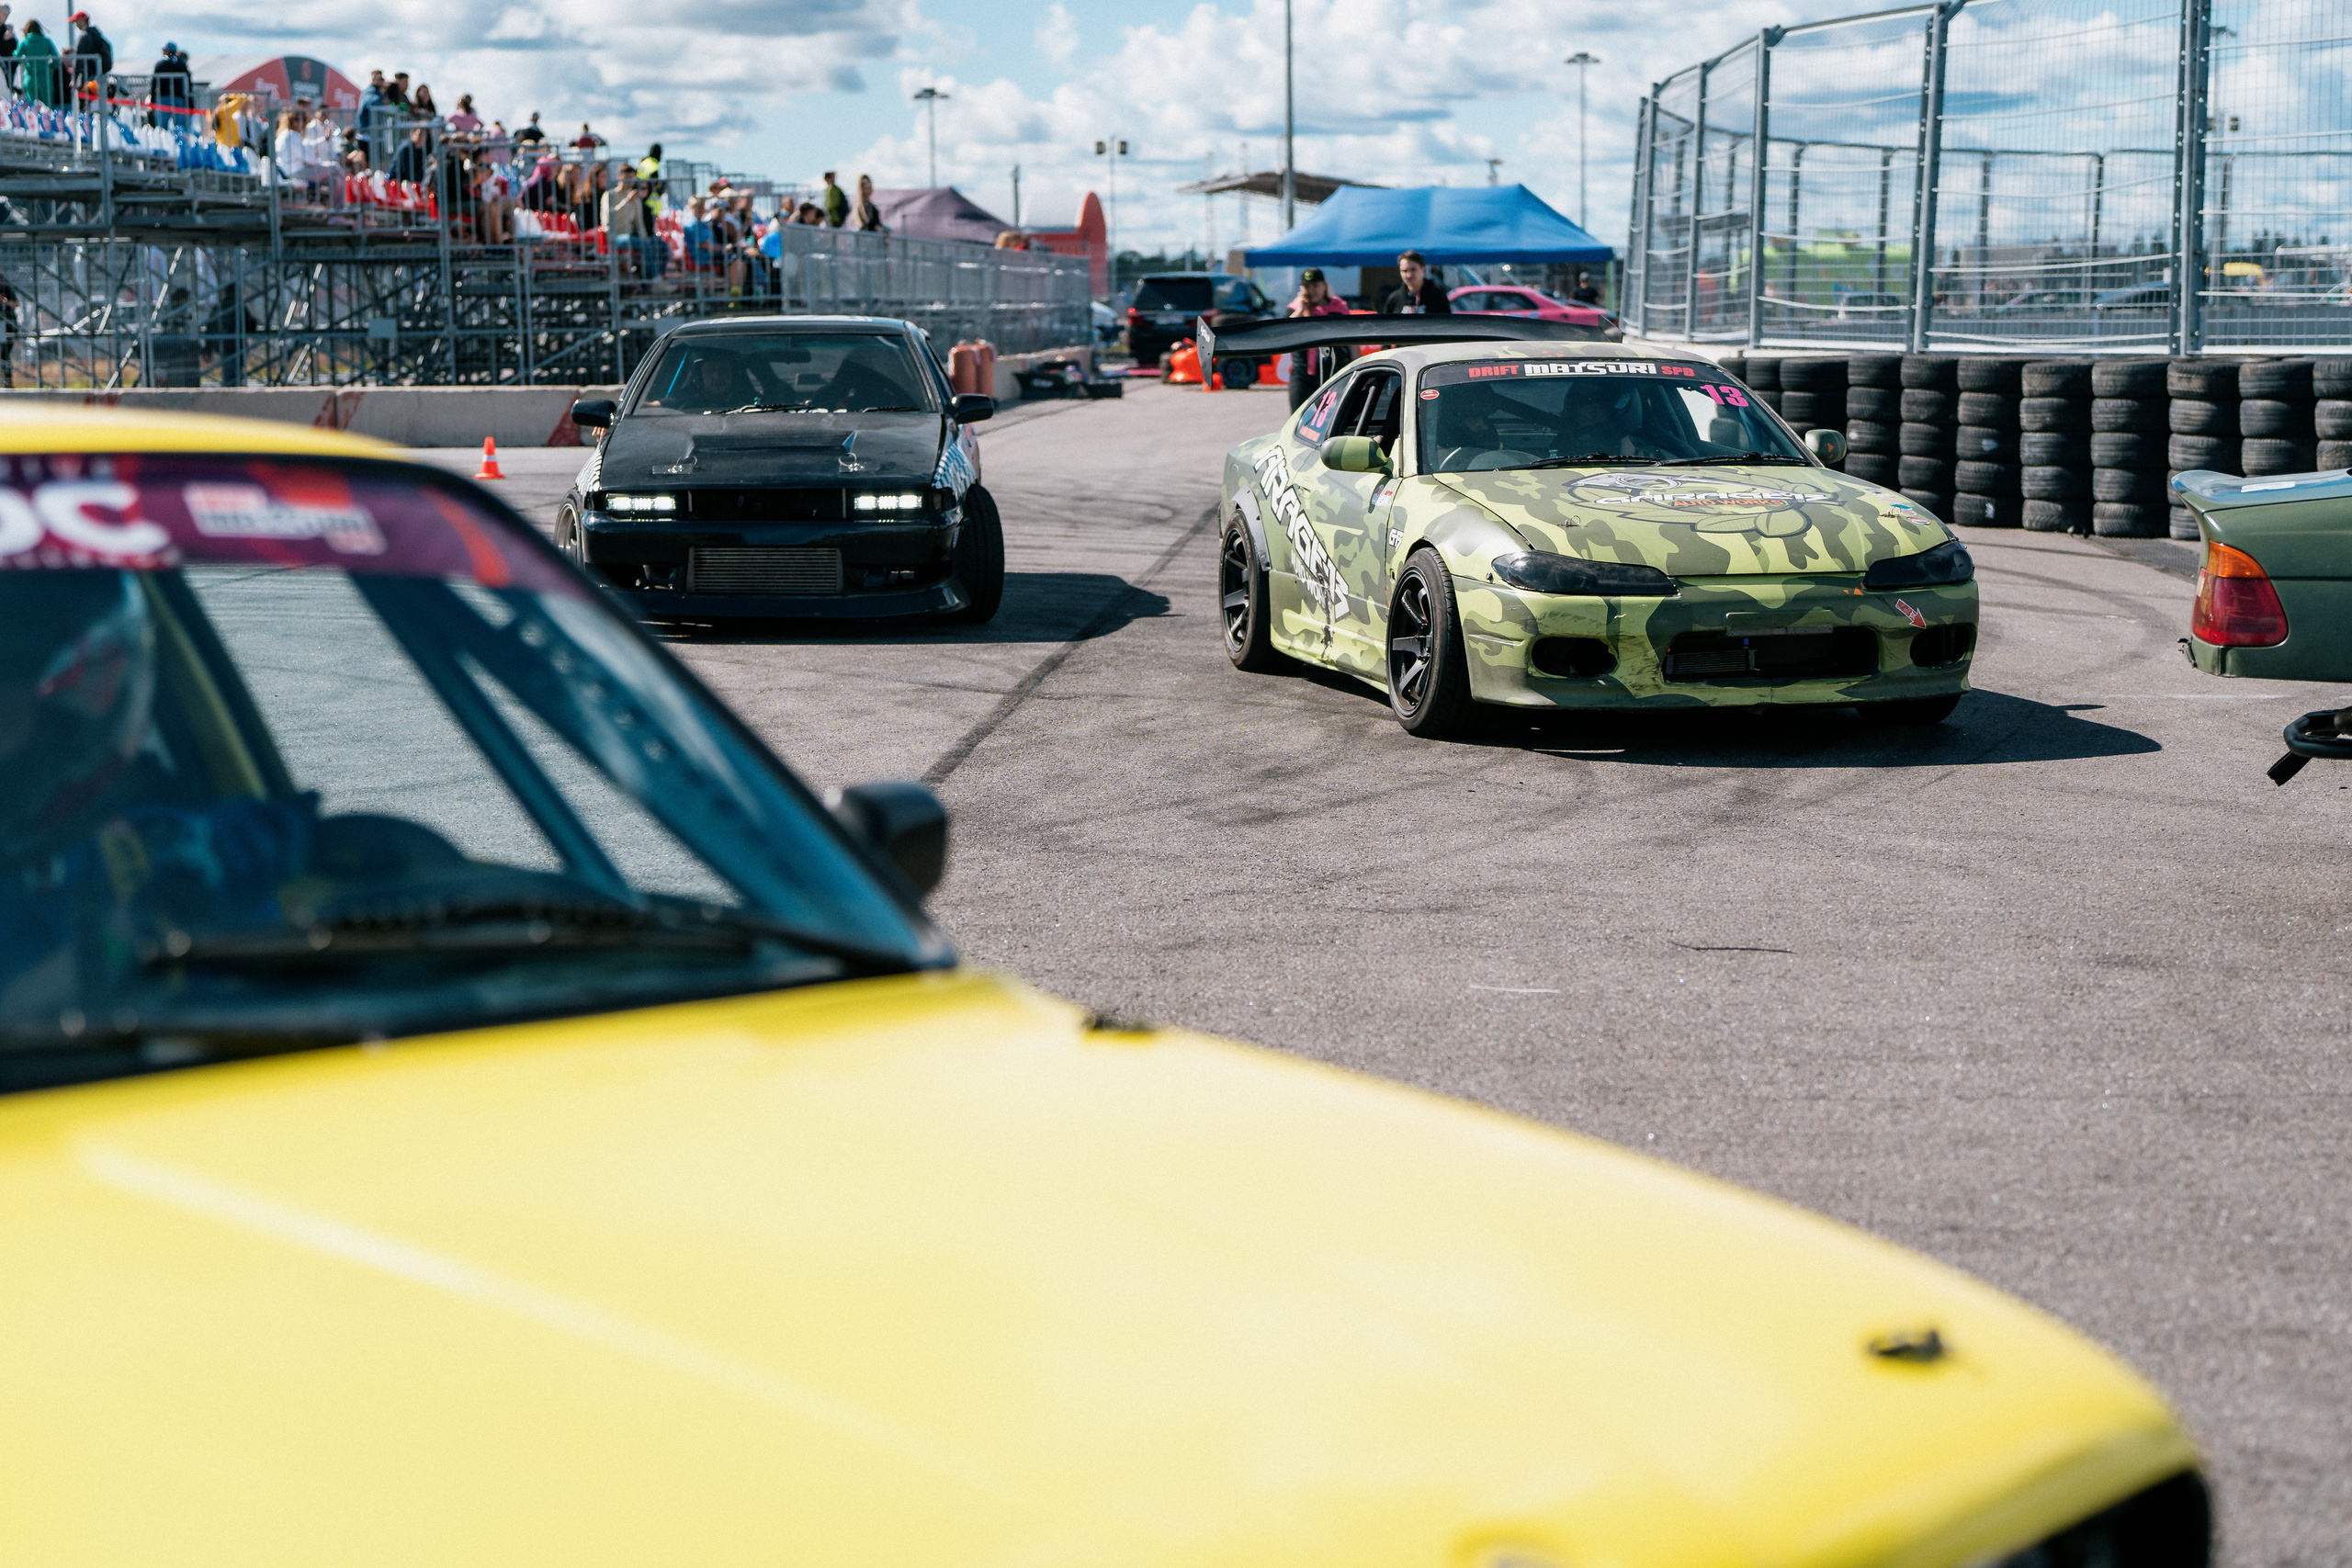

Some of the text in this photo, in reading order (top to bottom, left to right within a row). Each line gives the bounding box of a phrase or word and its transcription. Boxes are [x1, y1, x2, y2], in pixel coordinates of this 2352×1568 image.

[1468, 361, 1695, 378] DRIFT MATSURI SPB
[1700, 384, 1749, 407] 13
[1311, 390, 1338, 428] 13
